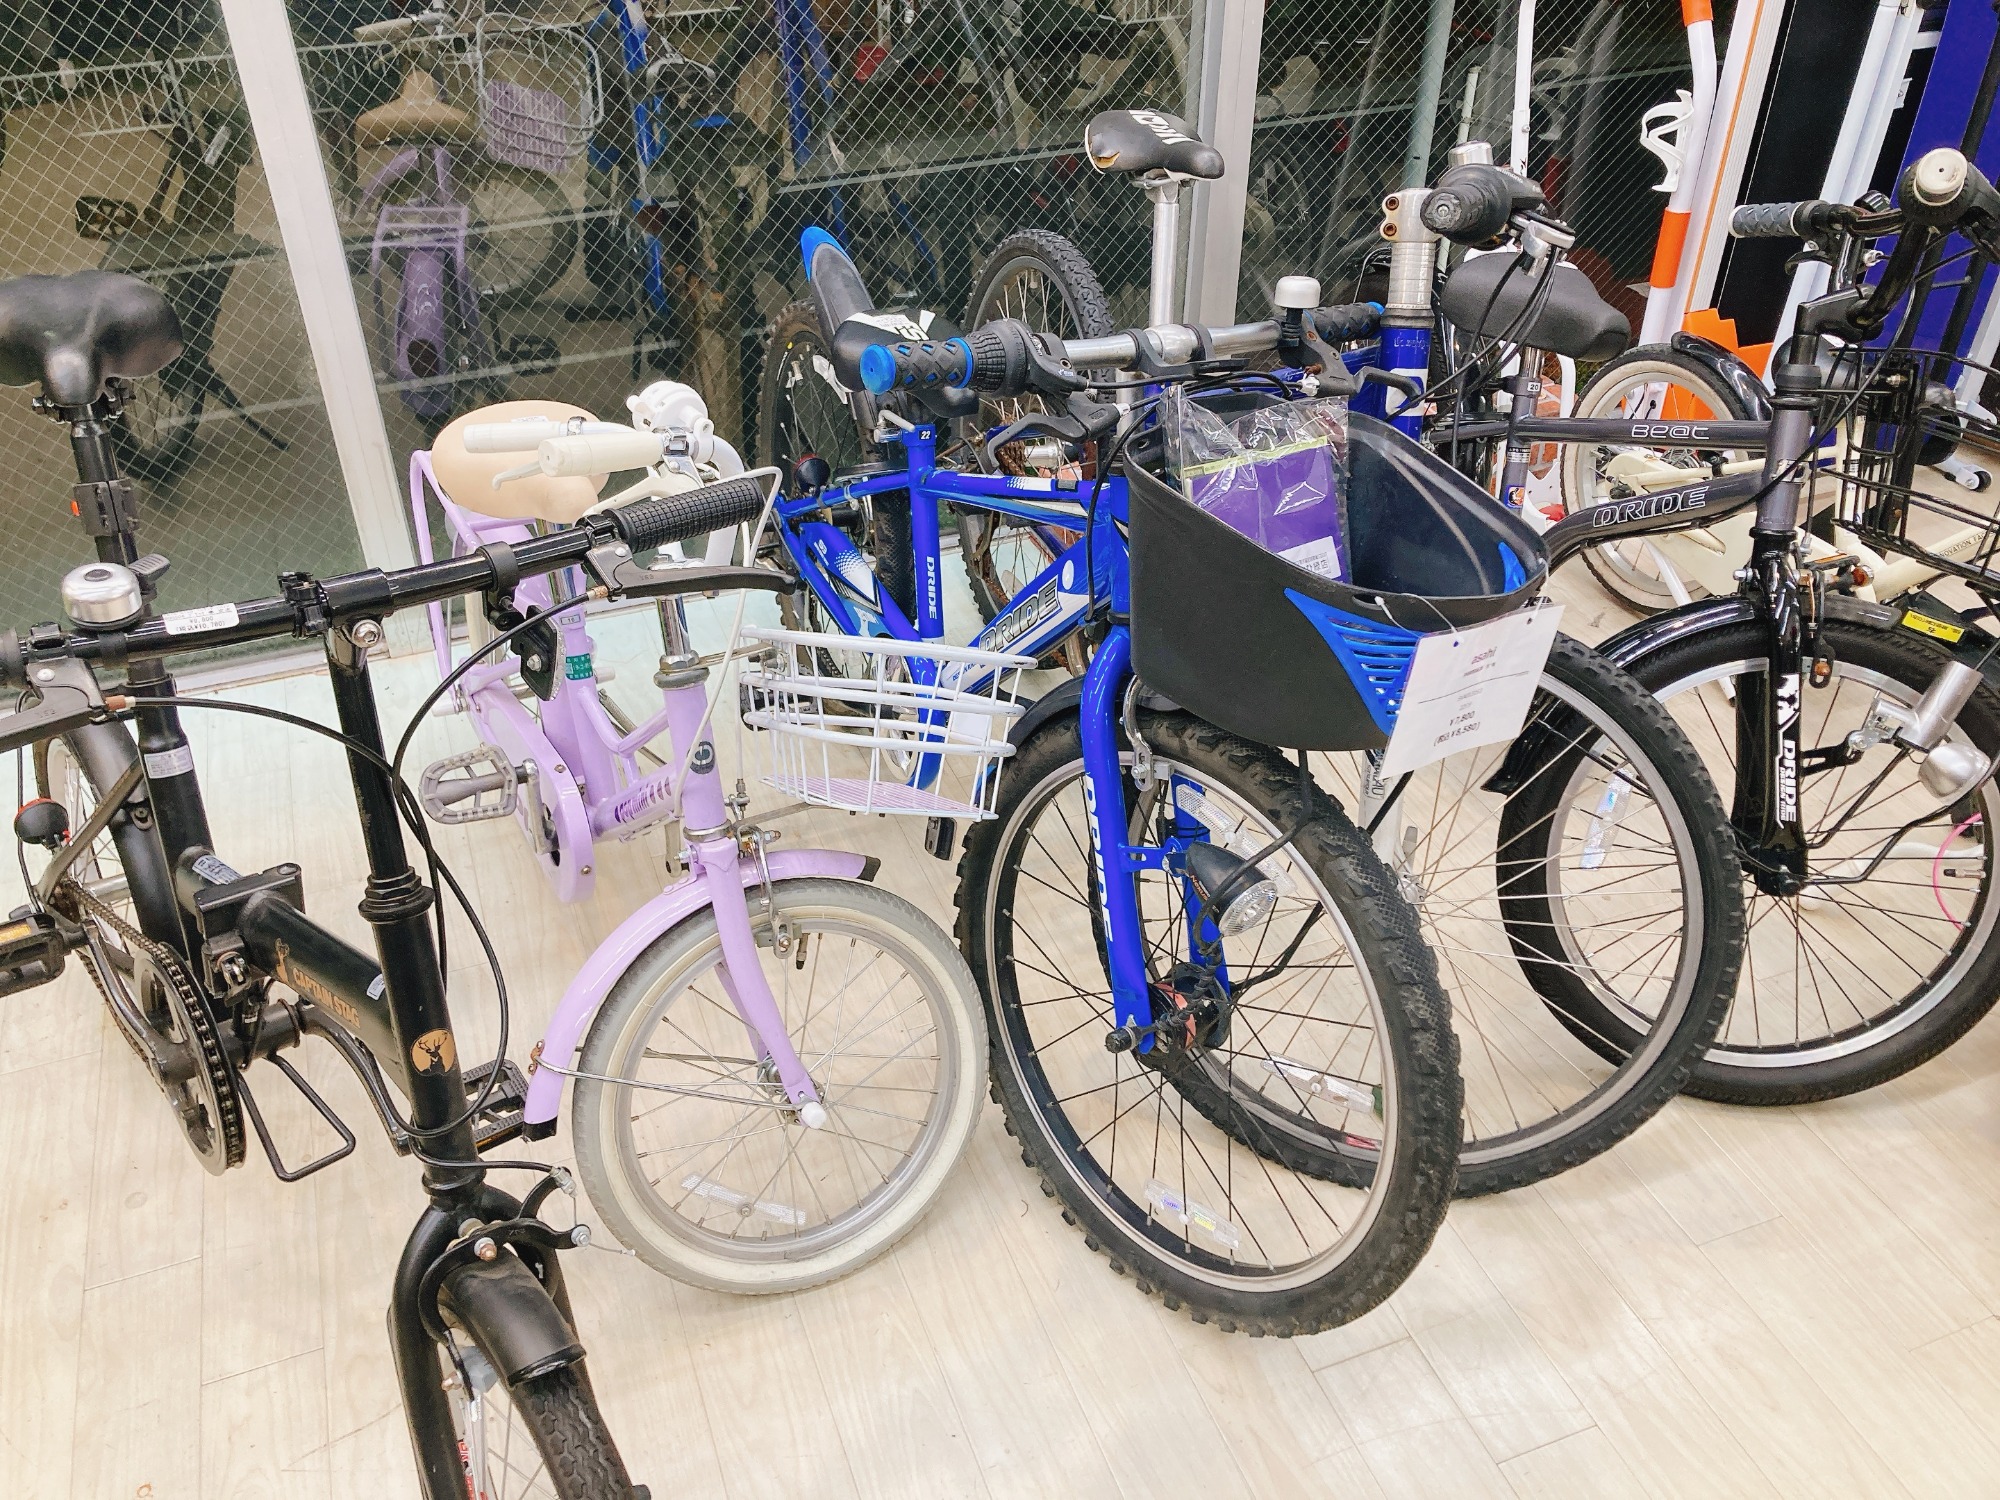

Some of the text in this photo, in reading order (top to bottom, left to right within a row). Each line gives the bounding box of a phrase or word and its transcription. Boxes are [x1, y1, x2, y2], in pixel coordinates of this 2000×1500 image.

[1529, 383, 1539, 391] 20
[920, 430, 931, 440] 22
[1592, 485, 1710, 528] DRIDE
[926, 556, 938, 620] DRIDE
[979, 575, 1063, 652] DRIDE
[1471, 646, 1498, 665] asahi
[1450, 710, 1476, 727] ¥7,800
[1784, 739, 1797, 822] DRIDE
[293, 968, 361, 1028] CAPTAIN STAG
